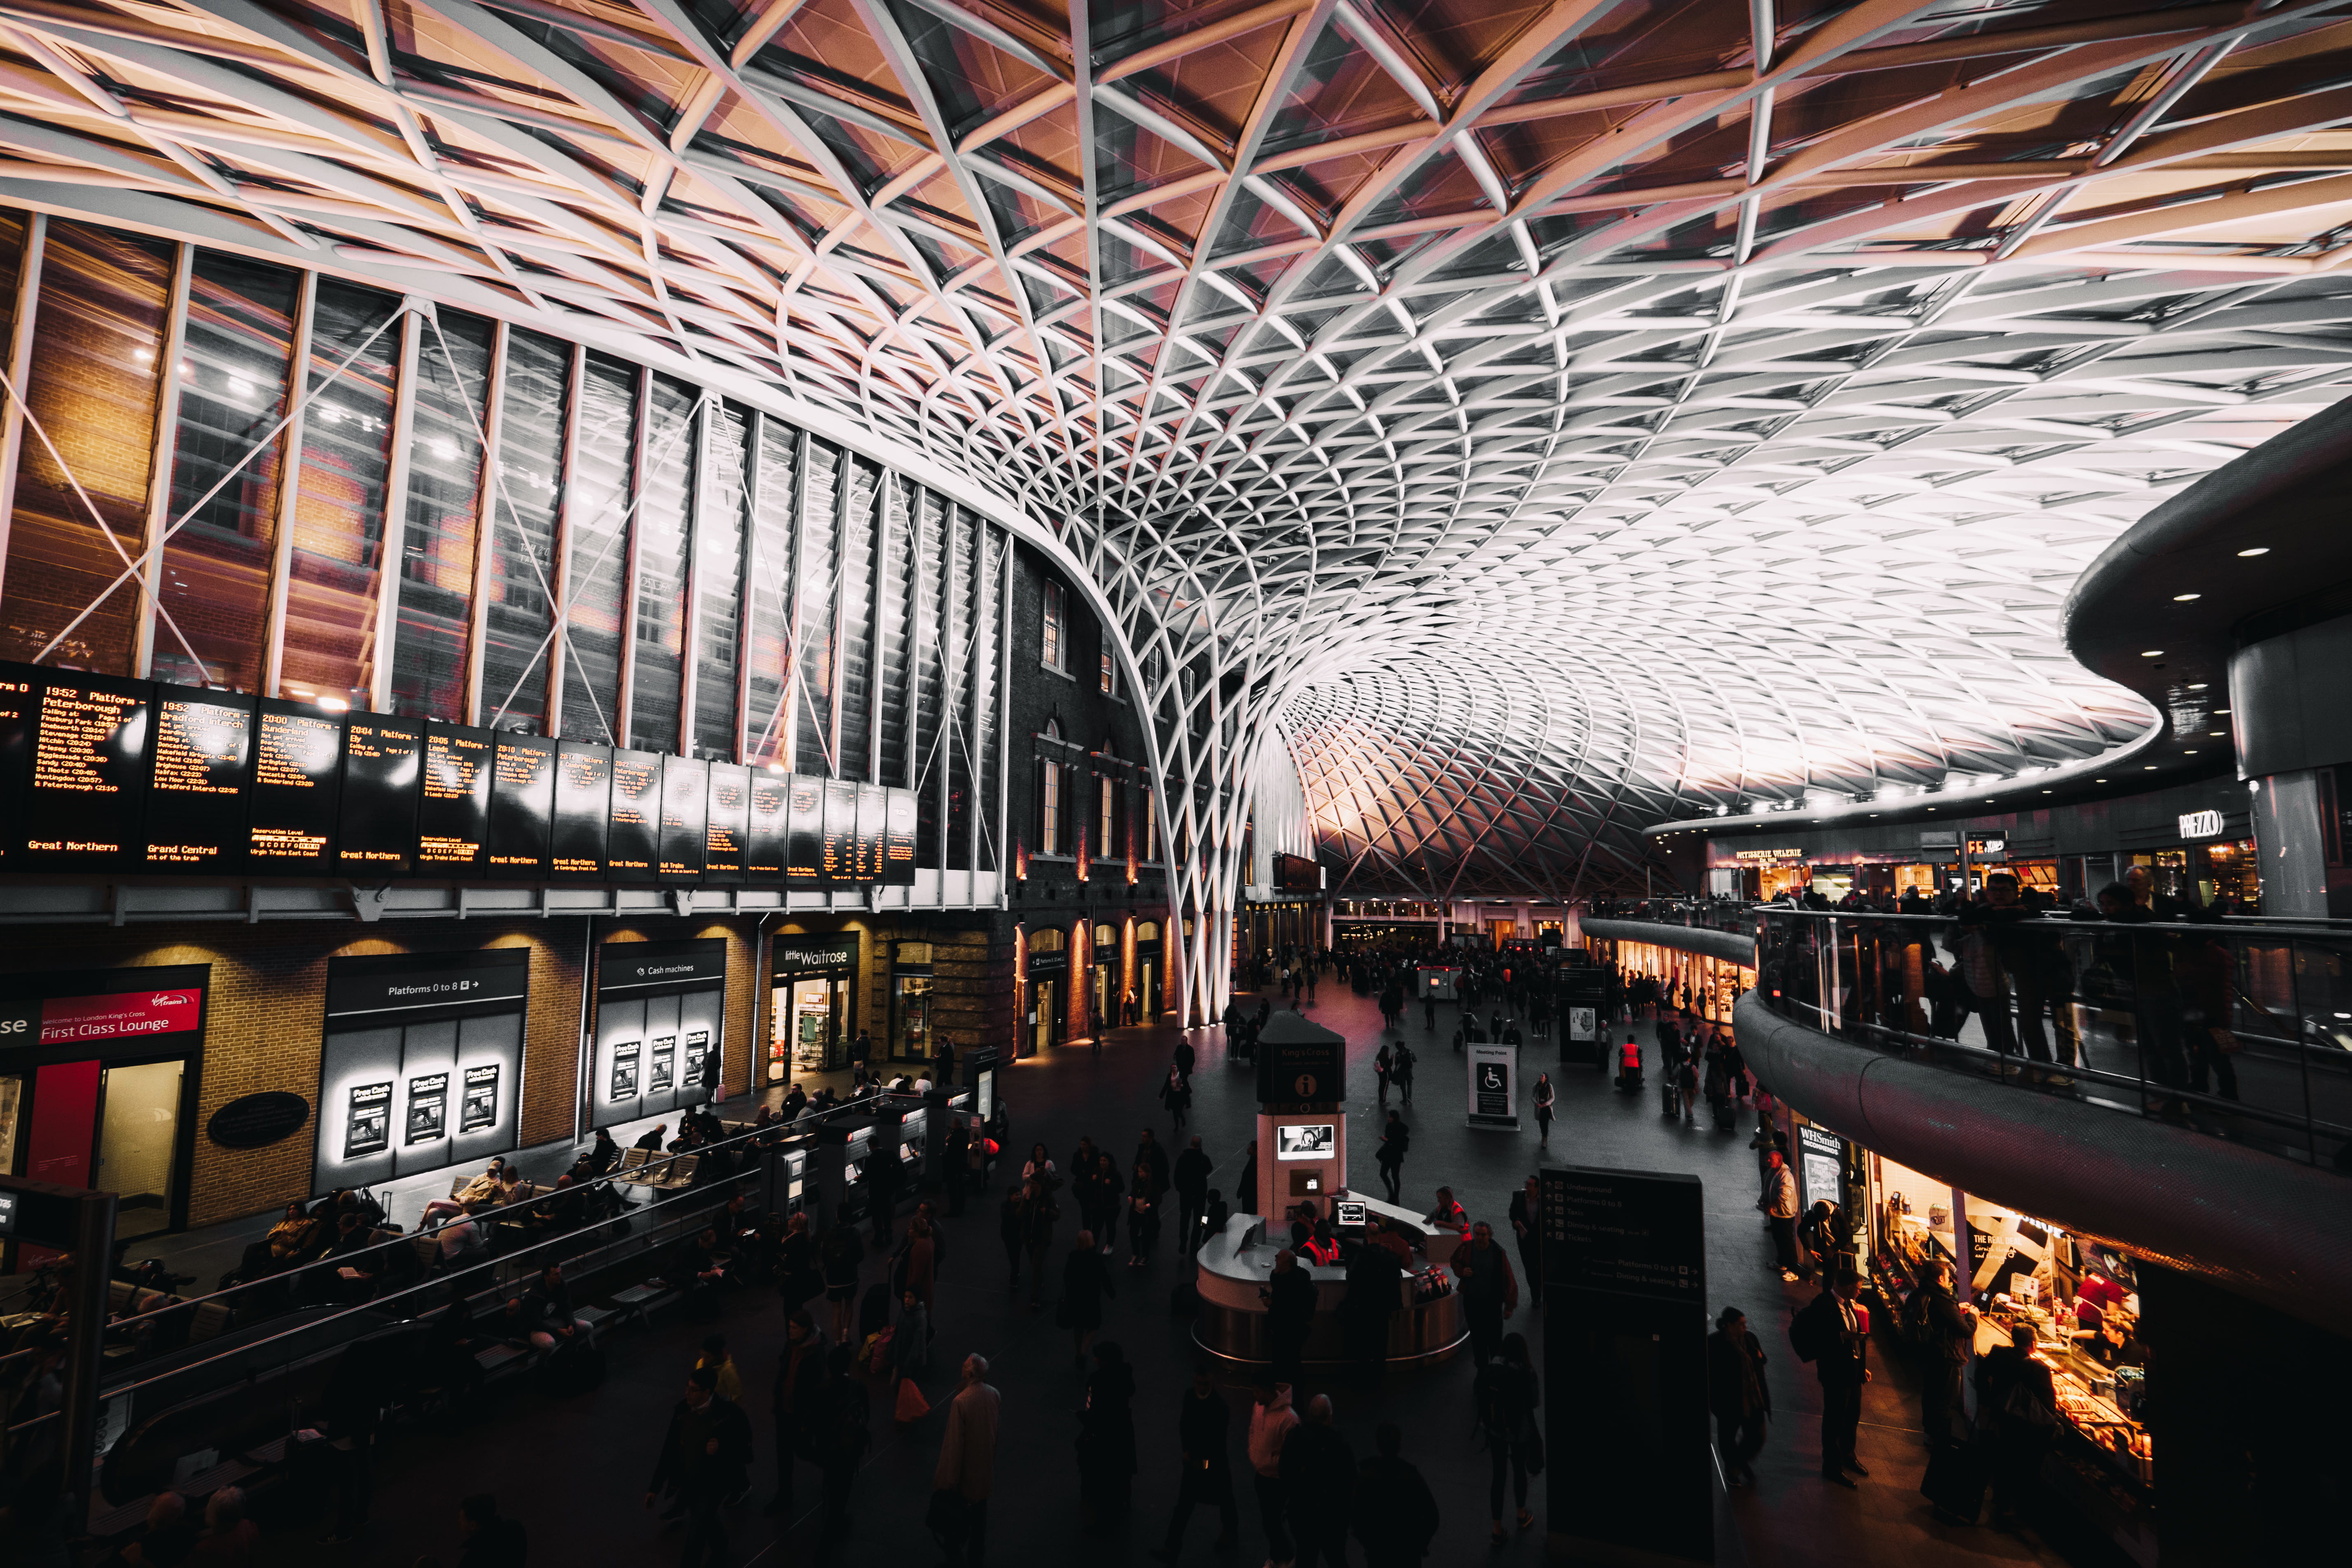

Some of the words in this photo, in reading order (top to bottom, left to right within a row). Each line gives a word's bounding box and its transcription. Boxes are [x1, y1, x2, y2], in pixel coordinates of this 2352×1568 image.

[19, 684, 29, 692] 0
[46, 686, 77, 698] 19:52
[90, 692, 135, 706] Platform
[43, 697, 120, 715] Peterborough
[163, 701, 189, 713] 19:52
[201, 706, 240, 718] Platform
[42, 708, 66, 716] Calling
[41, 715, 73, 724] Finsbury
[94, 720, 118, 729] (19:57)
[161, 711, 204, 724] Bradford
[209, 717, 243, 729] Interch
[262, 714, 287, 724] 20:00
[297, 719, 331, 729] Platform
[40, 722, 79, 731] Knebworth
[82, 726, 105, 734] (20:14)
[262, 724, 308, 736] Sunderland
[351, 725, 372, 735] 20:04
[381, 729, 411, 740] Platform
[40, 729, 79, 739] Stevenage
[350, 734, 362, 743] Ely
[428, 735, 448, 745] 20:05
[456, 739, 483, 749] Platform
[38, 744, 66, 752] Arlesey
[428, 744, 448, 753] Leeds
[498, 745, 515, 753] 20:10
[521, 748, 546, 757] Platform
[37, 751, 80, 761] Biggleswade
[157, 748, 187, 757] Wakefield
[189, 751, 215, 760] Kirkgate
[497, 753, 538, 764] Peterborough
[156, 762, 187, 770] Brighouse
[259, 758, 287, 766] Darlington
[35, 773, 75, 782] Huntingdon
[43, 781, 92, 791] Peterborough
[2179, 810, 2219, 839] PREZZO
[28, 841, 62, 850] Great
[66, 841, 118, 851] Northern
[148, 845, 178, 853] Grand
[182, 845, 217, 855] Central
[365, 851, 400, 860] Northern
[1736, 850, 1771, 859] PATISSERIE
[1772, 848, 1802, 857] VALERIE
[785, 949, 800, 961] little
[801, 949, 847, 965] Waitrose
[648, 967, 663, 975] Cash
[665, 965, 694, 974] machines
[388, 985, 431, 996] Platforms
[452, 982, 458, 991] 8
[151, 993, 169, 1007] Virgin
[41, 1026, 75, 1040] First
[79, 1023, 115, 1036] Class
[120, 1019, 169, 1033] Lounge
[1282, 1048, 1305, 1058] King's
[467, 1069, 481, 1078] Free
[482, 1067, 497, 1076] Cash
[412, 1079, 429, 1088] Free
[430, 1076, 446, 1085] Cash
[353, 1088, 371, 1098] Free
[372, 1085, 390, 1094] Cash
[1800, 1127, 1841, 1149] WHSmith
[1803, 1139, 1838, 1155] RECOMMENDS
[1567, 1183, 1611, 1193] Underground
[1567, 1196, 1600, 1205] Platforms
[1567, 1221, 1590, 1230] Dining
[1599, 1225, 1625, 1235] seating
[1567, 1234, 1592, 1243] Tickets
[1974, 1235, 1987, 1243] THE
[1988, 1235, 2004, 1244] REAL
[2005, 1237, 2022, 1246] DEAL
[1996, 1246, 2017, 1258] through
[1986, 1253, 2007, 1264] through
[1618, 1260, 1652, 1270] Platforms
[1616, 1273, 1639, 1282] Dining
[1649, 1276, 1675, 1286] seating
